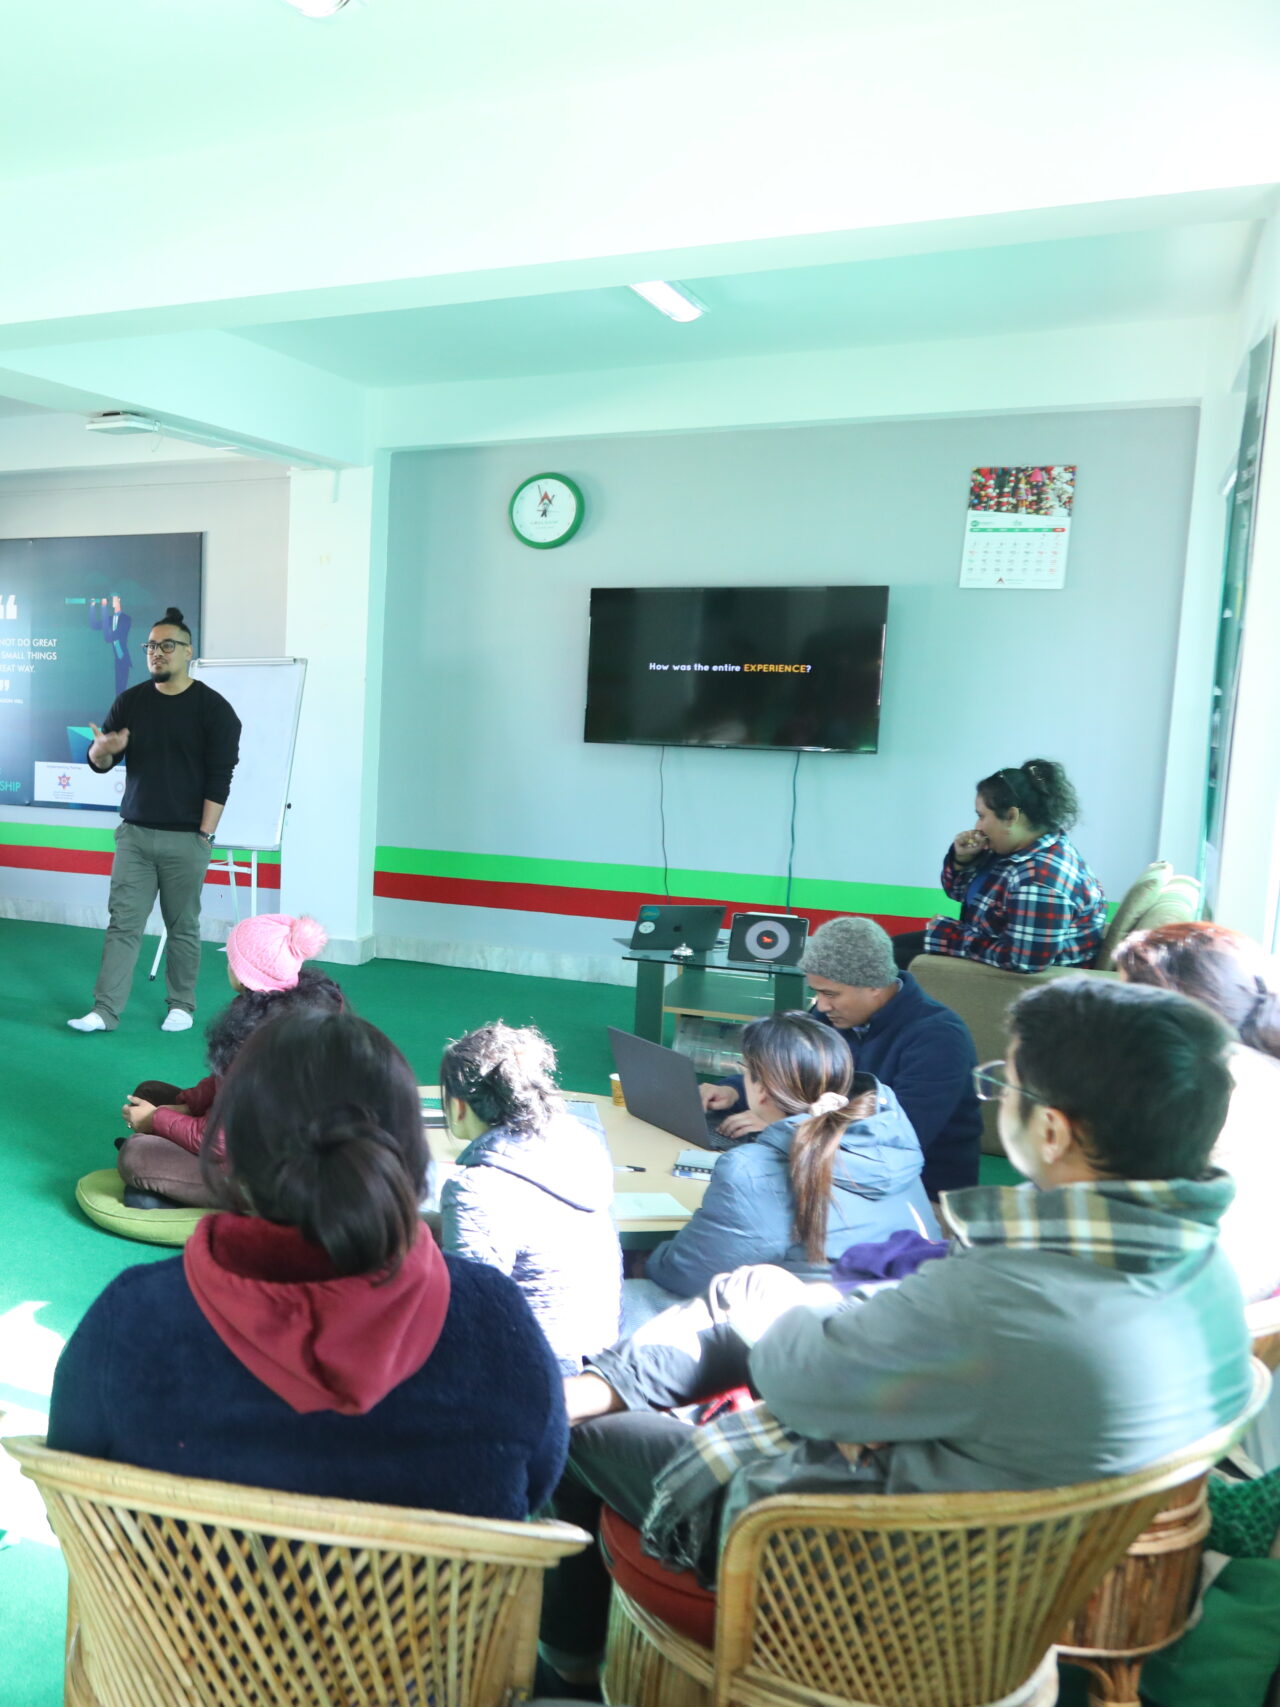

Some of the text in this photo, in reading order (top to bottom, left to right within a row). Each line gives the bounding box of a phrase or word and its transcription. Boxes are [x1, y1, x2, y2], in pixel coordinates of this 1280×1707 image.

[17, 638, 30, 647] DO
[32, 638, 57, 648] GREAT
[1, 651, 24, 660] SMALL
[27, 651, 57, 661] THINGS
[18, 664, 36, 673] WAY.
[649, 662, 669, 671] How
[694, 663, 709, 671] the
[712, 663, 741, 672] entire
[743, 663, 811, 673] EXPERIENCE?
